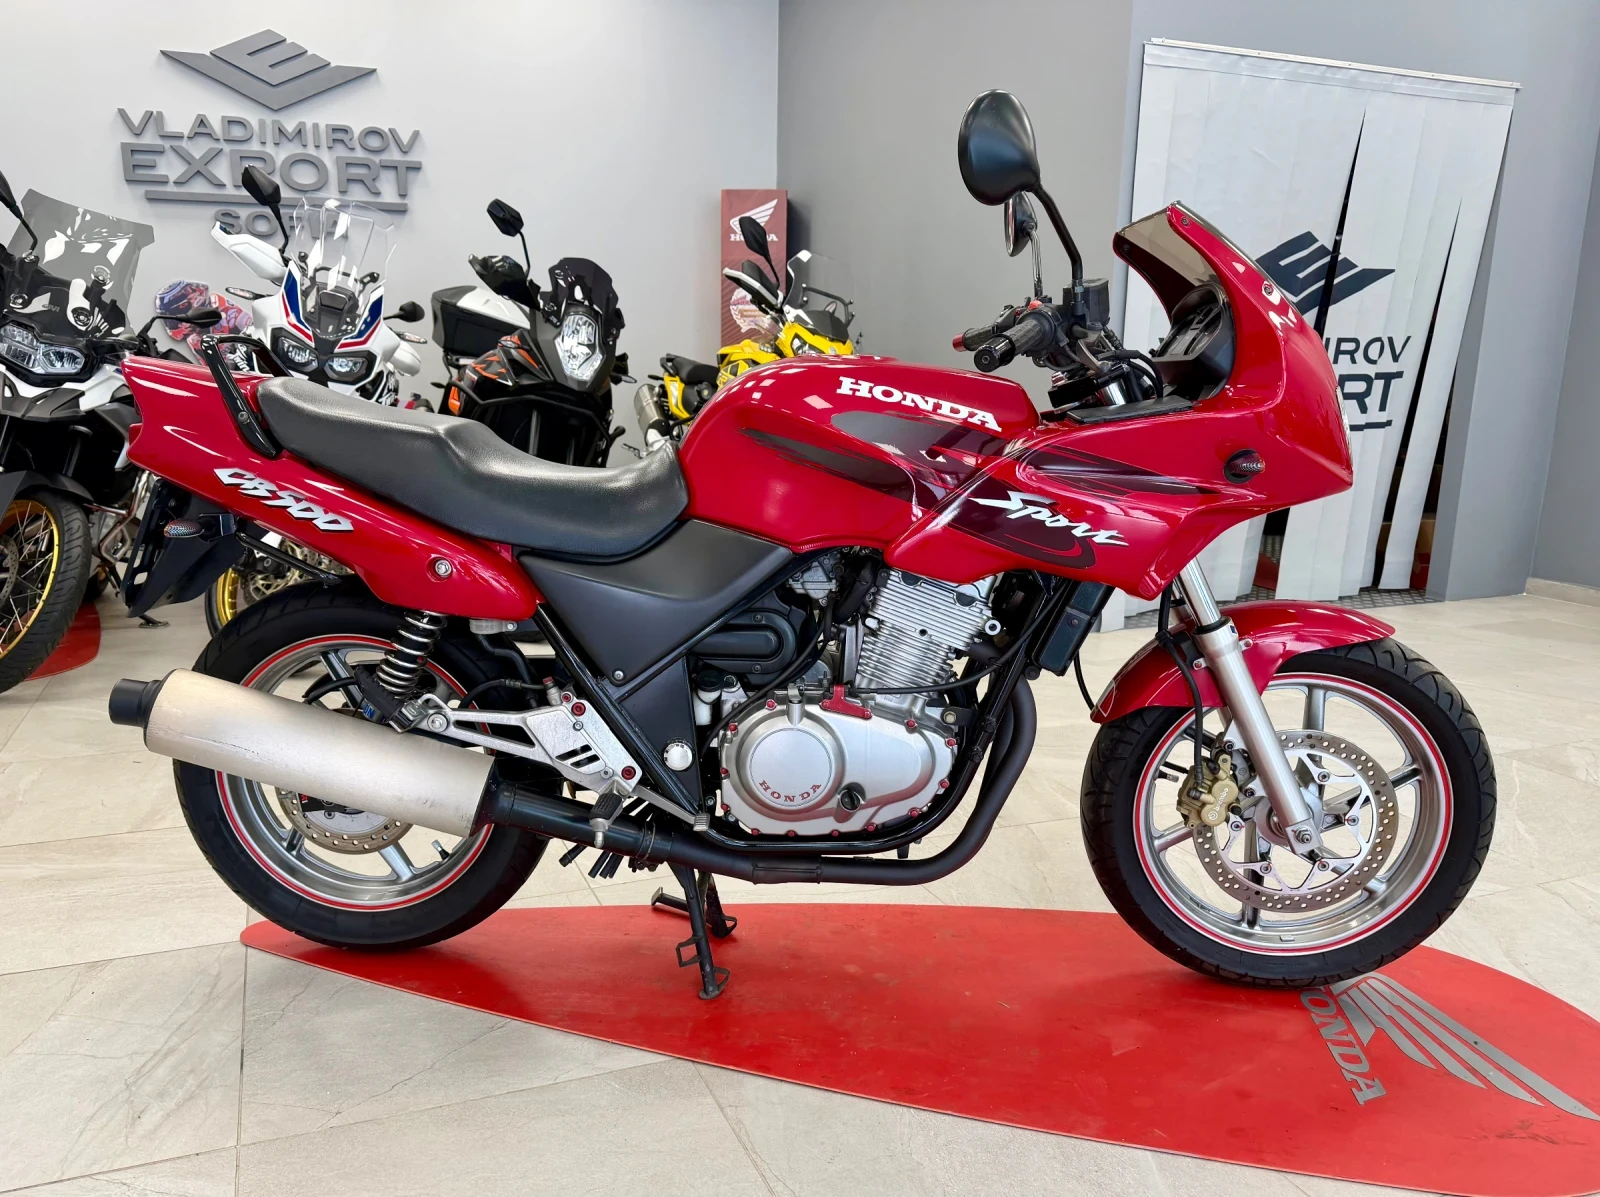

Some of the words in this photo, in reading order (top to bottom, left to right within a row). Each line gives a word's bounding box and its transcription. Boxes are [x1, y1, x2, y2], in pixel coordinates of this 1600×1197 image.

[117, 107, 420, 154] VLADIMIROV
[120, 142, 422, 196] EXPORT
[836, 375, 1003, 432] HONDA
[967, 490, 1130, 547] Sport
[759, 779, 822, 803] HONDA
[1213, 787, 1229, 812] brembo
[1300, 985, 1387, 1106] ONDA
